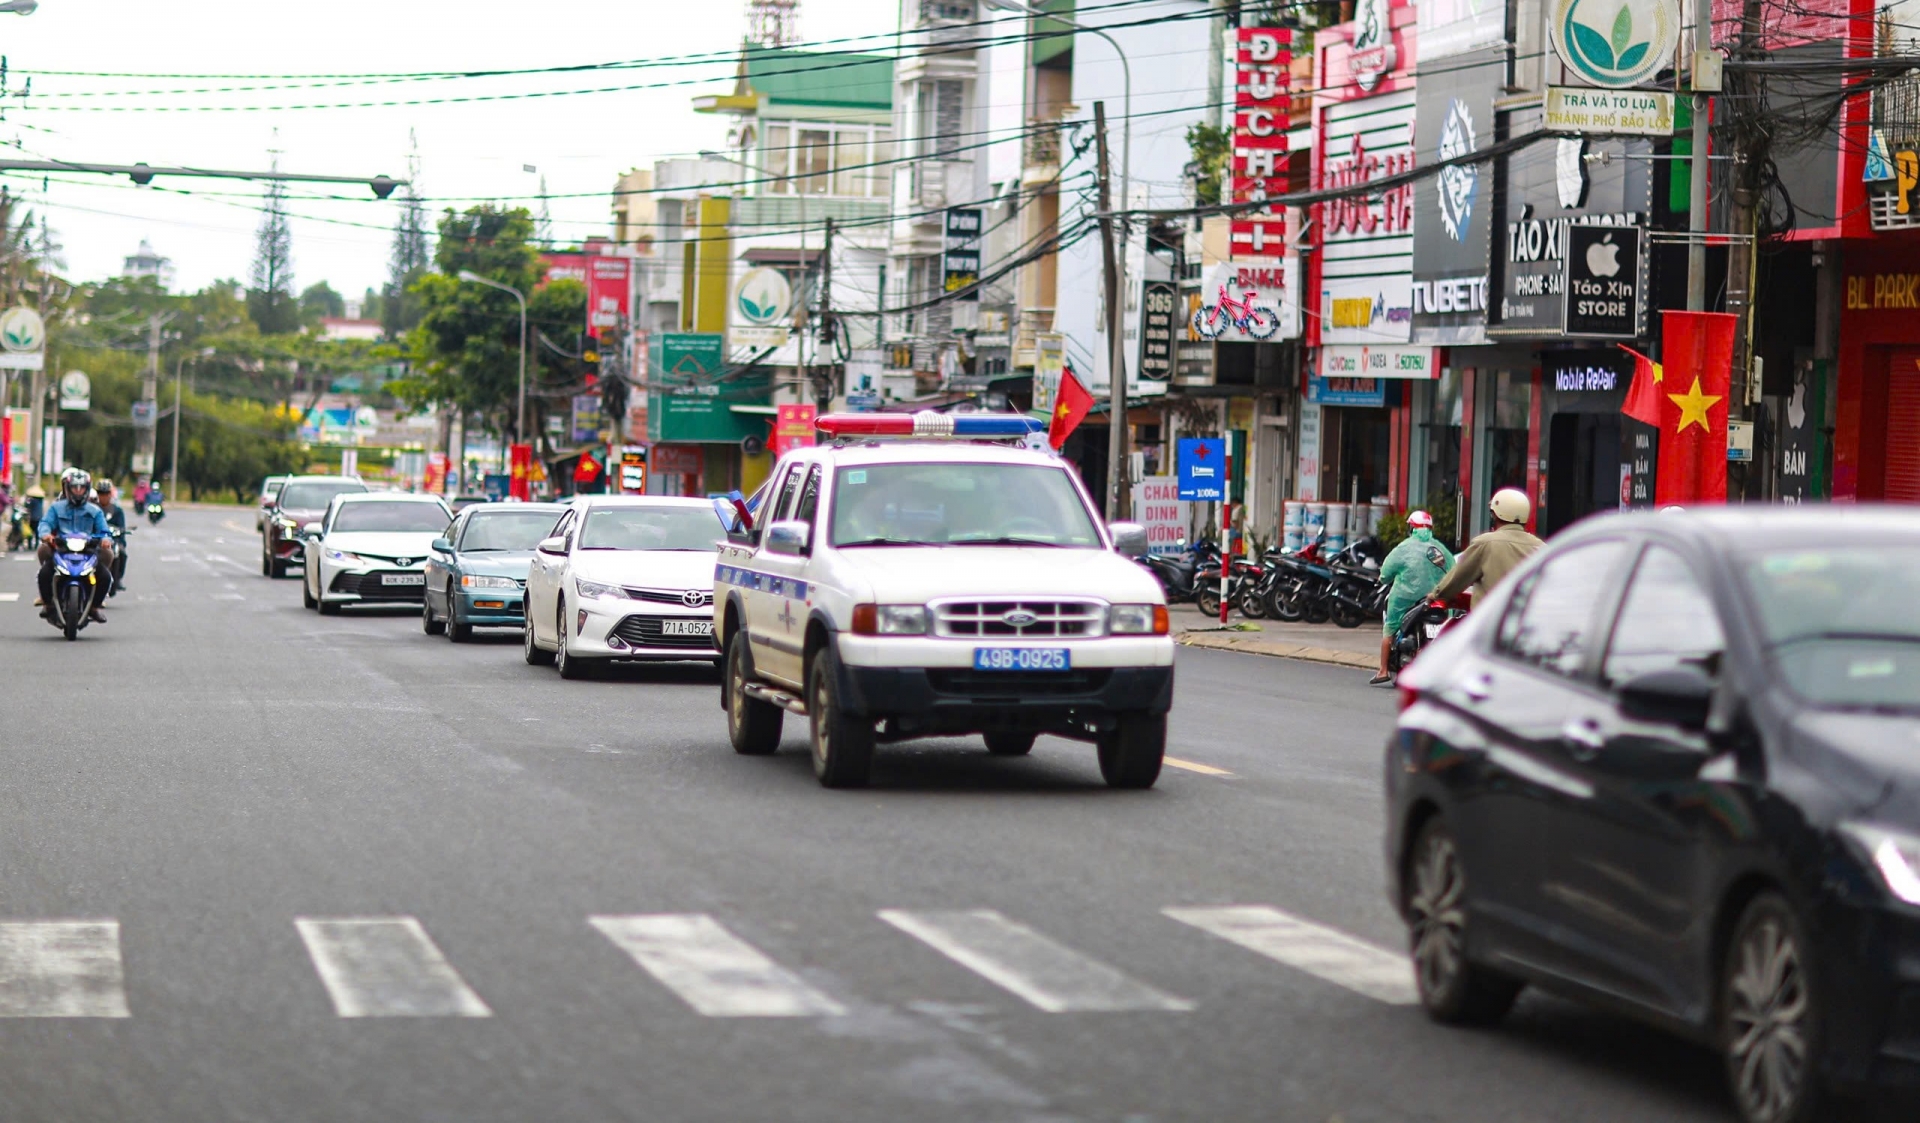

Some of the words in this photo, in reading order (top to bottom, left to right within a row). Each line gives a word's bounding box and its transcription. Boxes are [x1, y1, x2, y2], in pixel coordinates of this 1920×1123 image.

[1563, 91, 1588, 107] TRÀ
[1592, 93, 1608, 108] VÀ
[1613, 96, 1629, 108] TƠ
[1632, 98, 1657, 113] LỤA
[1547, 110, 1589, 126] THÀNH
[1592, 110, 1617, 127] PHỐ
[1620, 111, 1645, 128] BẢO
[1649, 114, 1672, 131] LỘC
[1508, 202, 1543, 263] TÁO
[1237, 267, 1286, 290] BIKE
[1515, 274, 1544, 297] IPHONE
[1572, 278, 1602, 296] Táo
[1607, 280, 1633, 300] Xịn
[1147, 292, 1173, 313] 365
[1577, 301, 1627, 317] STORE
[1635, 454, 1649, 475] BÁN
[1783, 444, 1806, 477] BÁN
[1144, 483, 1178, 500] CHÁO
[1196, 488, 1220, 498] 1000m
[1145, 506, 1178, 521] DINH
[1145, 523, 1185, 542] ƯỠNG
[978, 649, 1066, 669] 49B-0925
